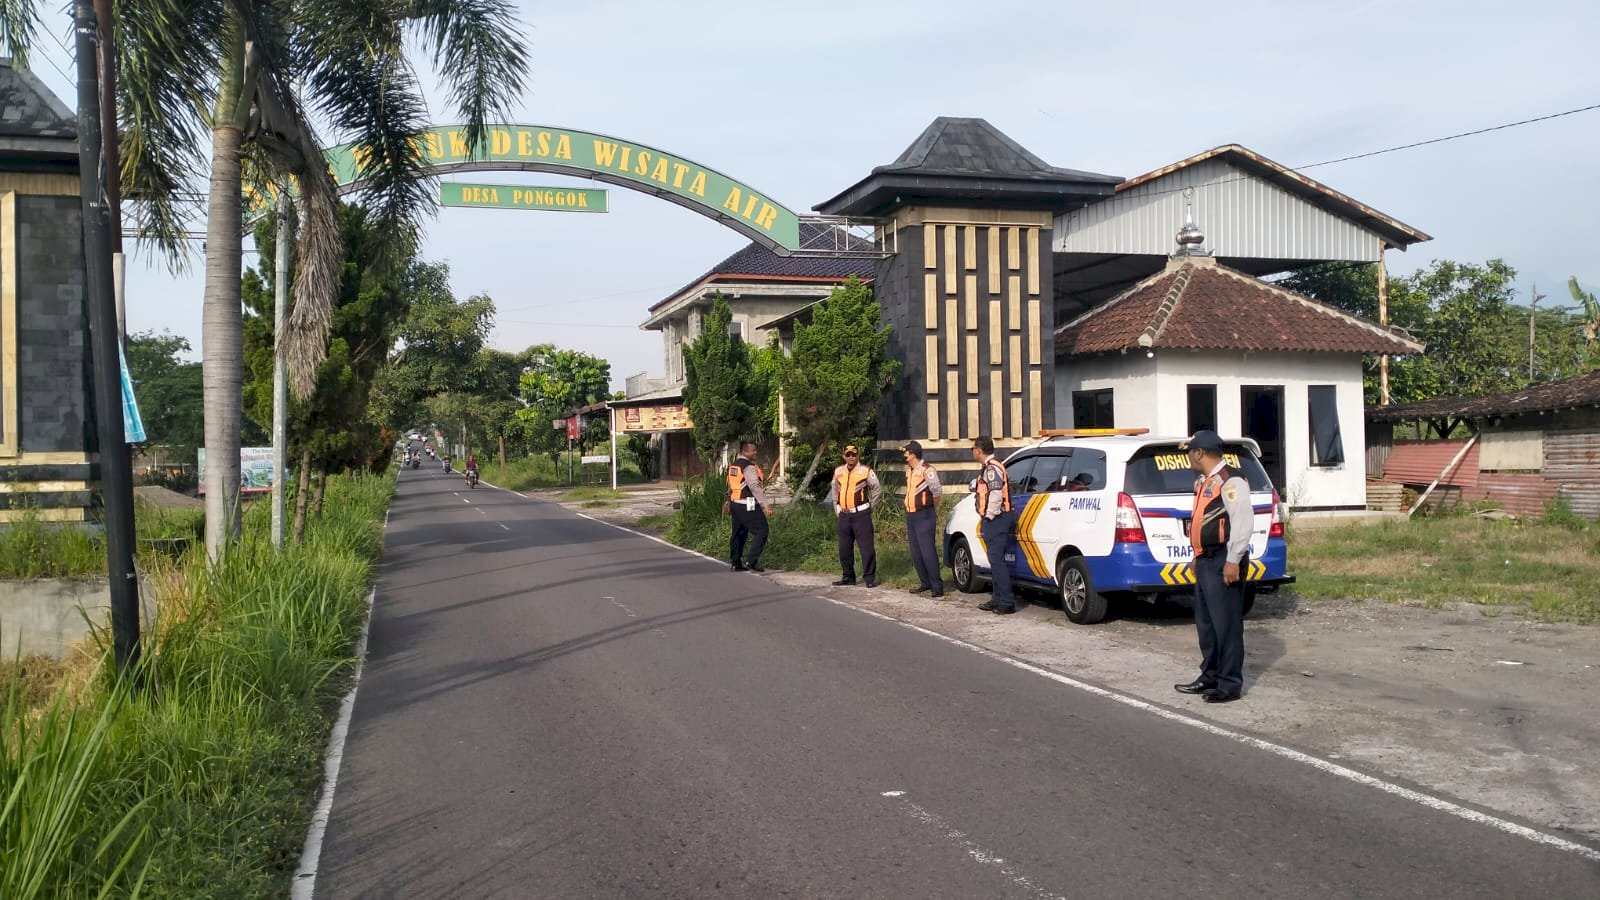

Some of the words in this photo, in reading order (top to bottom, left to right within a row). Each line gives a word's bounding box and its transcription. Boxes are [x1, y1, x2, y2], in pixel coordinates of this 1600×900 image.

[491, 129, 572, 160] DESA
[593, 139, 707, 197] WISATA
[722, 186, 777, 231] AIR
[462, 187, 498, 203] DESA
[513, 189, 587, 207] PONGGOK
[1154, 454, 1191, 471] DISHU
[1069, 497, 1101, 511] PAMWAL
